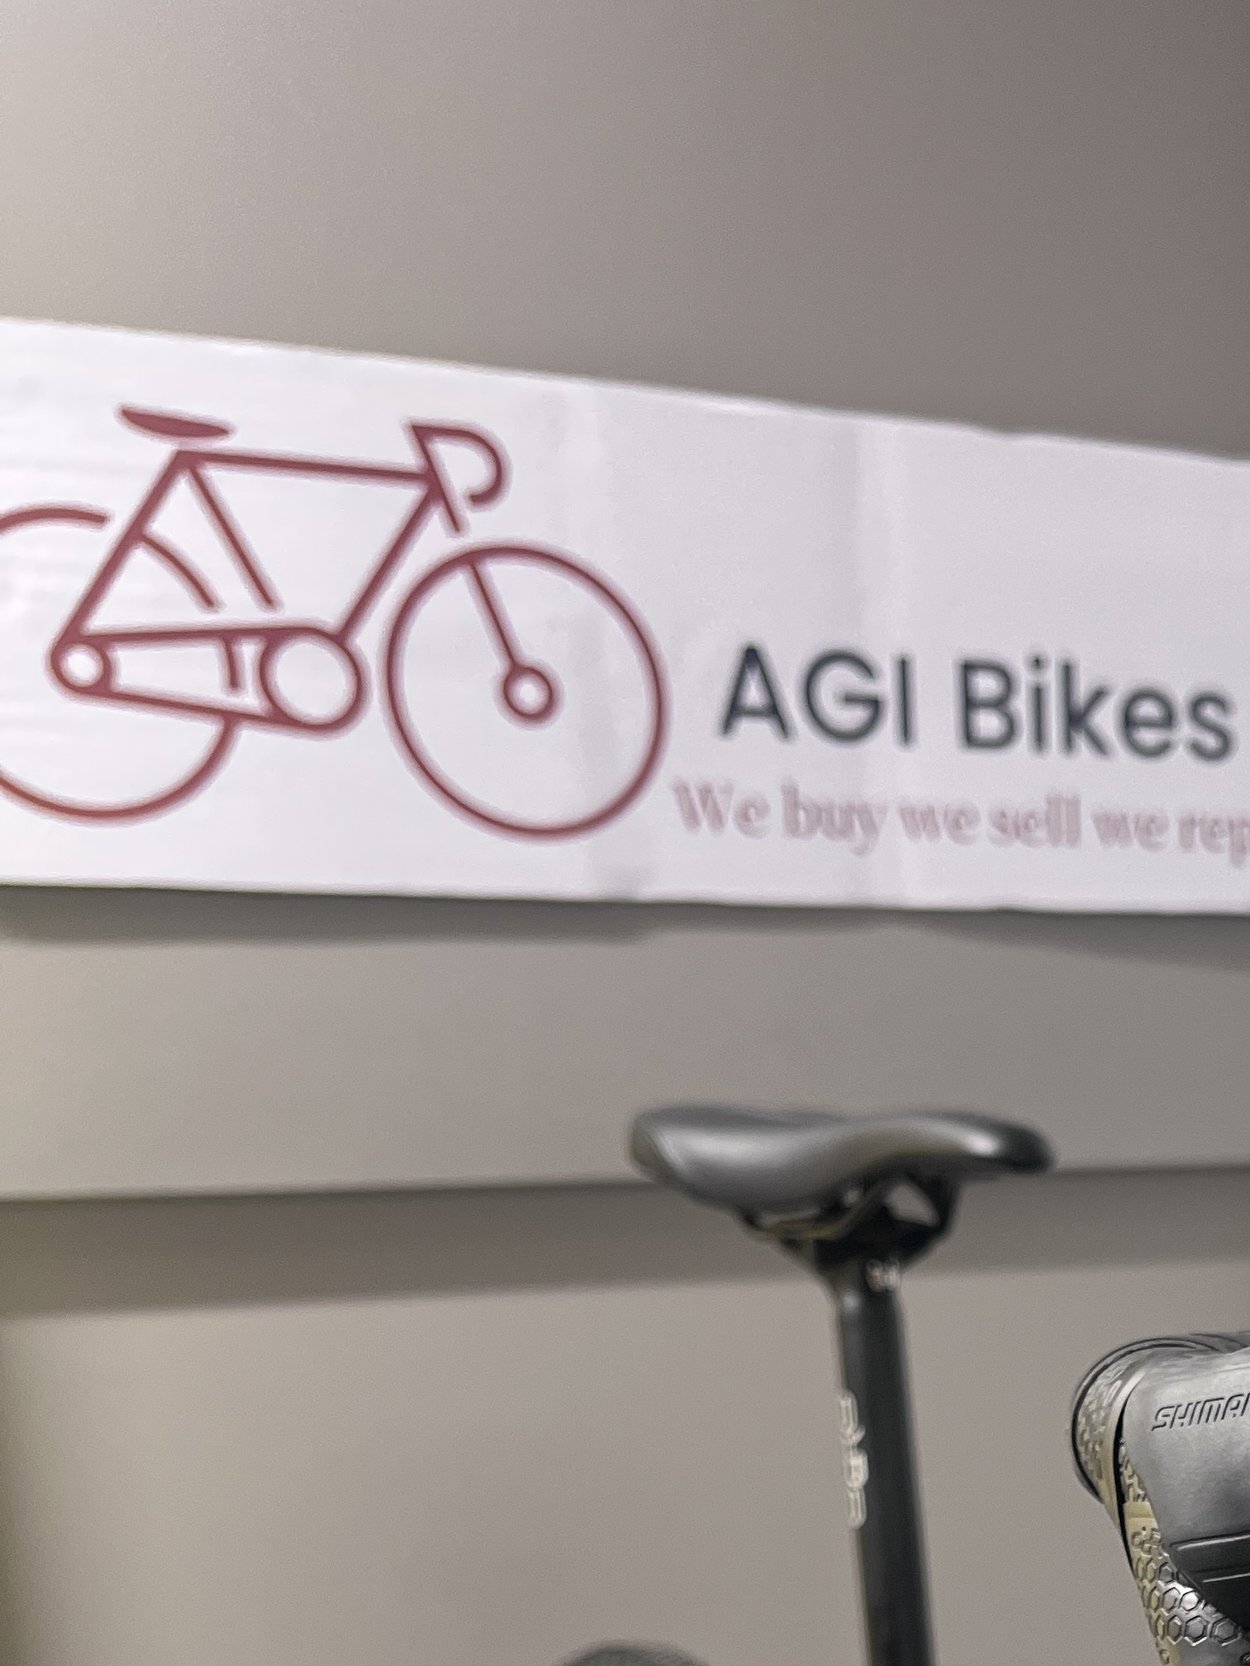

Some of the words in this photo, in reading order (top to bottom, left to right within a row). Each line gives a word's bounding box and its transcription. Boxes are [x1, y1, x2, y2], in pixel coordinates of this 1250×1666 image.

[718, 644, 912, 747] AGI
[957, 652, 1236, 764] Bikes
[674, 776, 771, 839] We
[780, 779, 887, 853] buy
[899, 800, 981, 844] we
[987, 793, 1082, 849] sell
[1092, 809, 1170, 851] we
